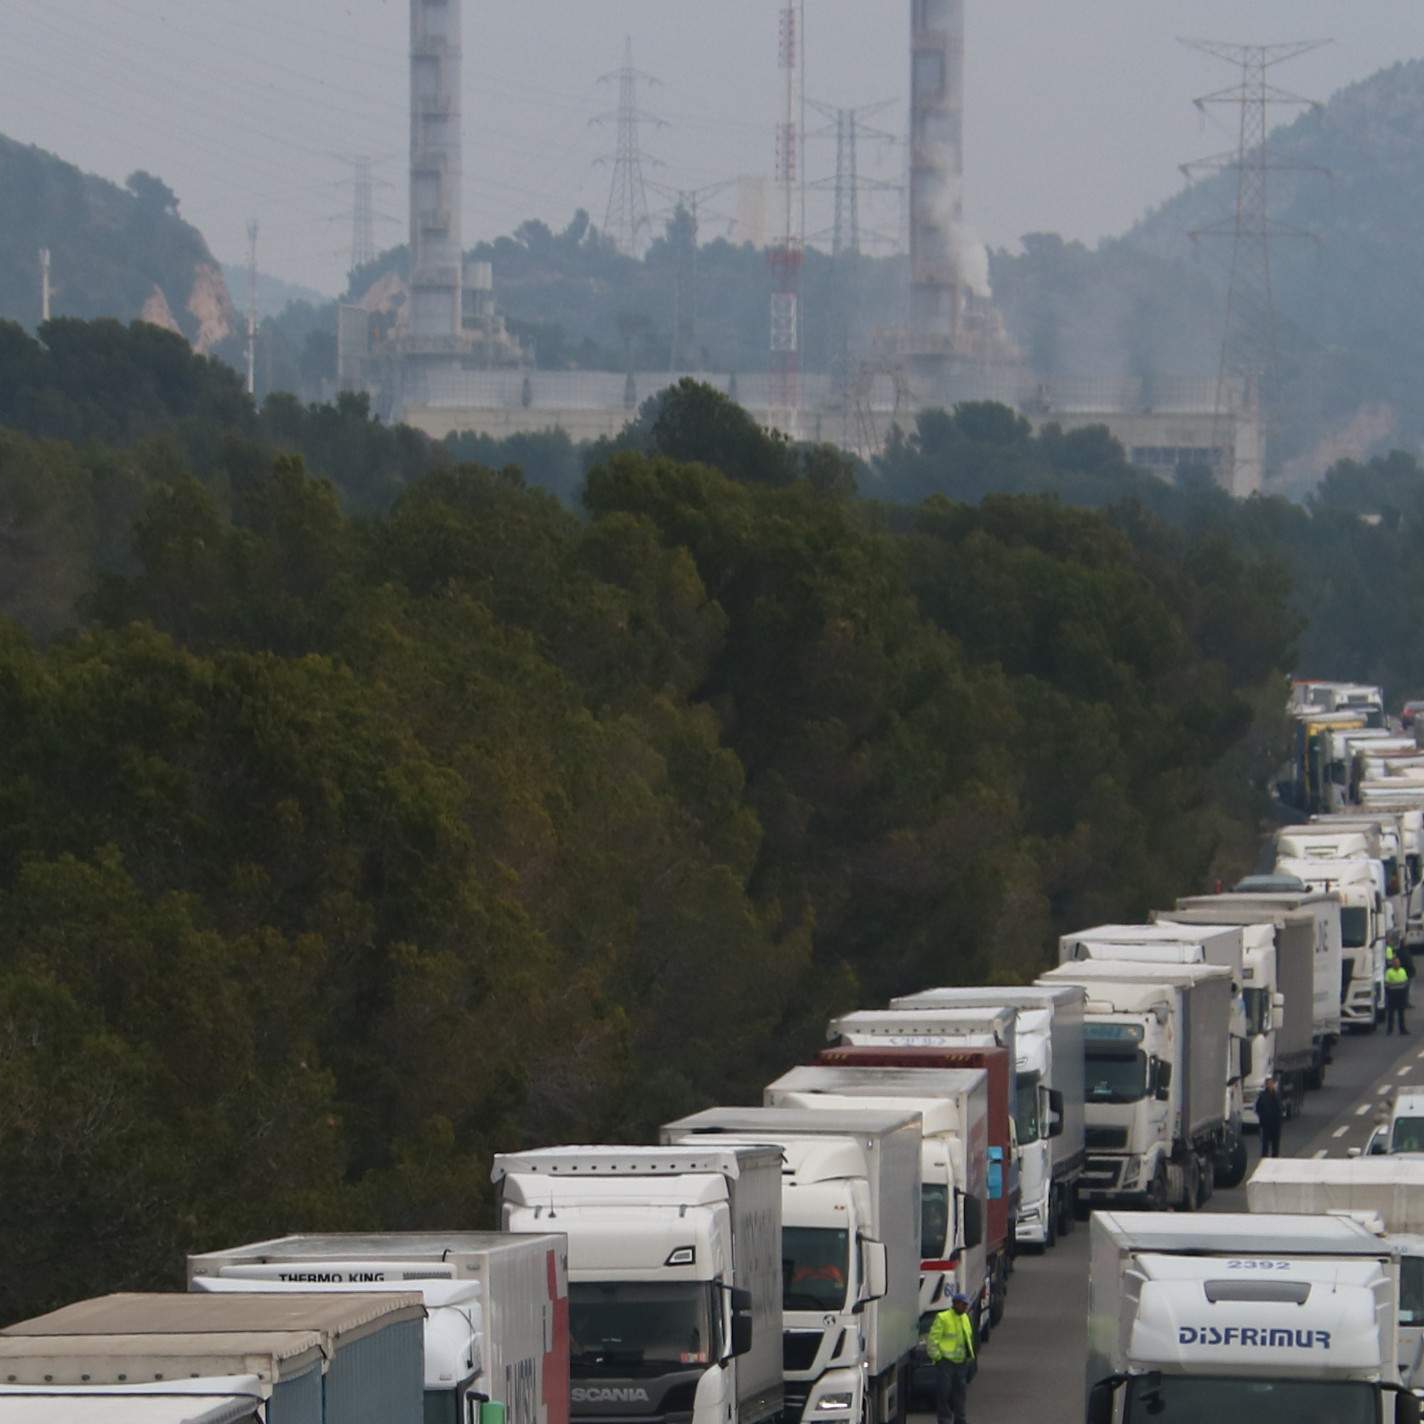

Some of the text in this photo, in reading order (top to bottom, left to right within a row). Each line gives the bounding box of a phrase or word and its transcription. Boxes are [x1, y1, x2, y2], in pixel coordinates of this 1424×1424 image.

[1226, 1259, 1292, 1270] 2392
[279, 1272, 384, 1283] THERMO KING
[571, 1387, 649, 1402] SCANIA
